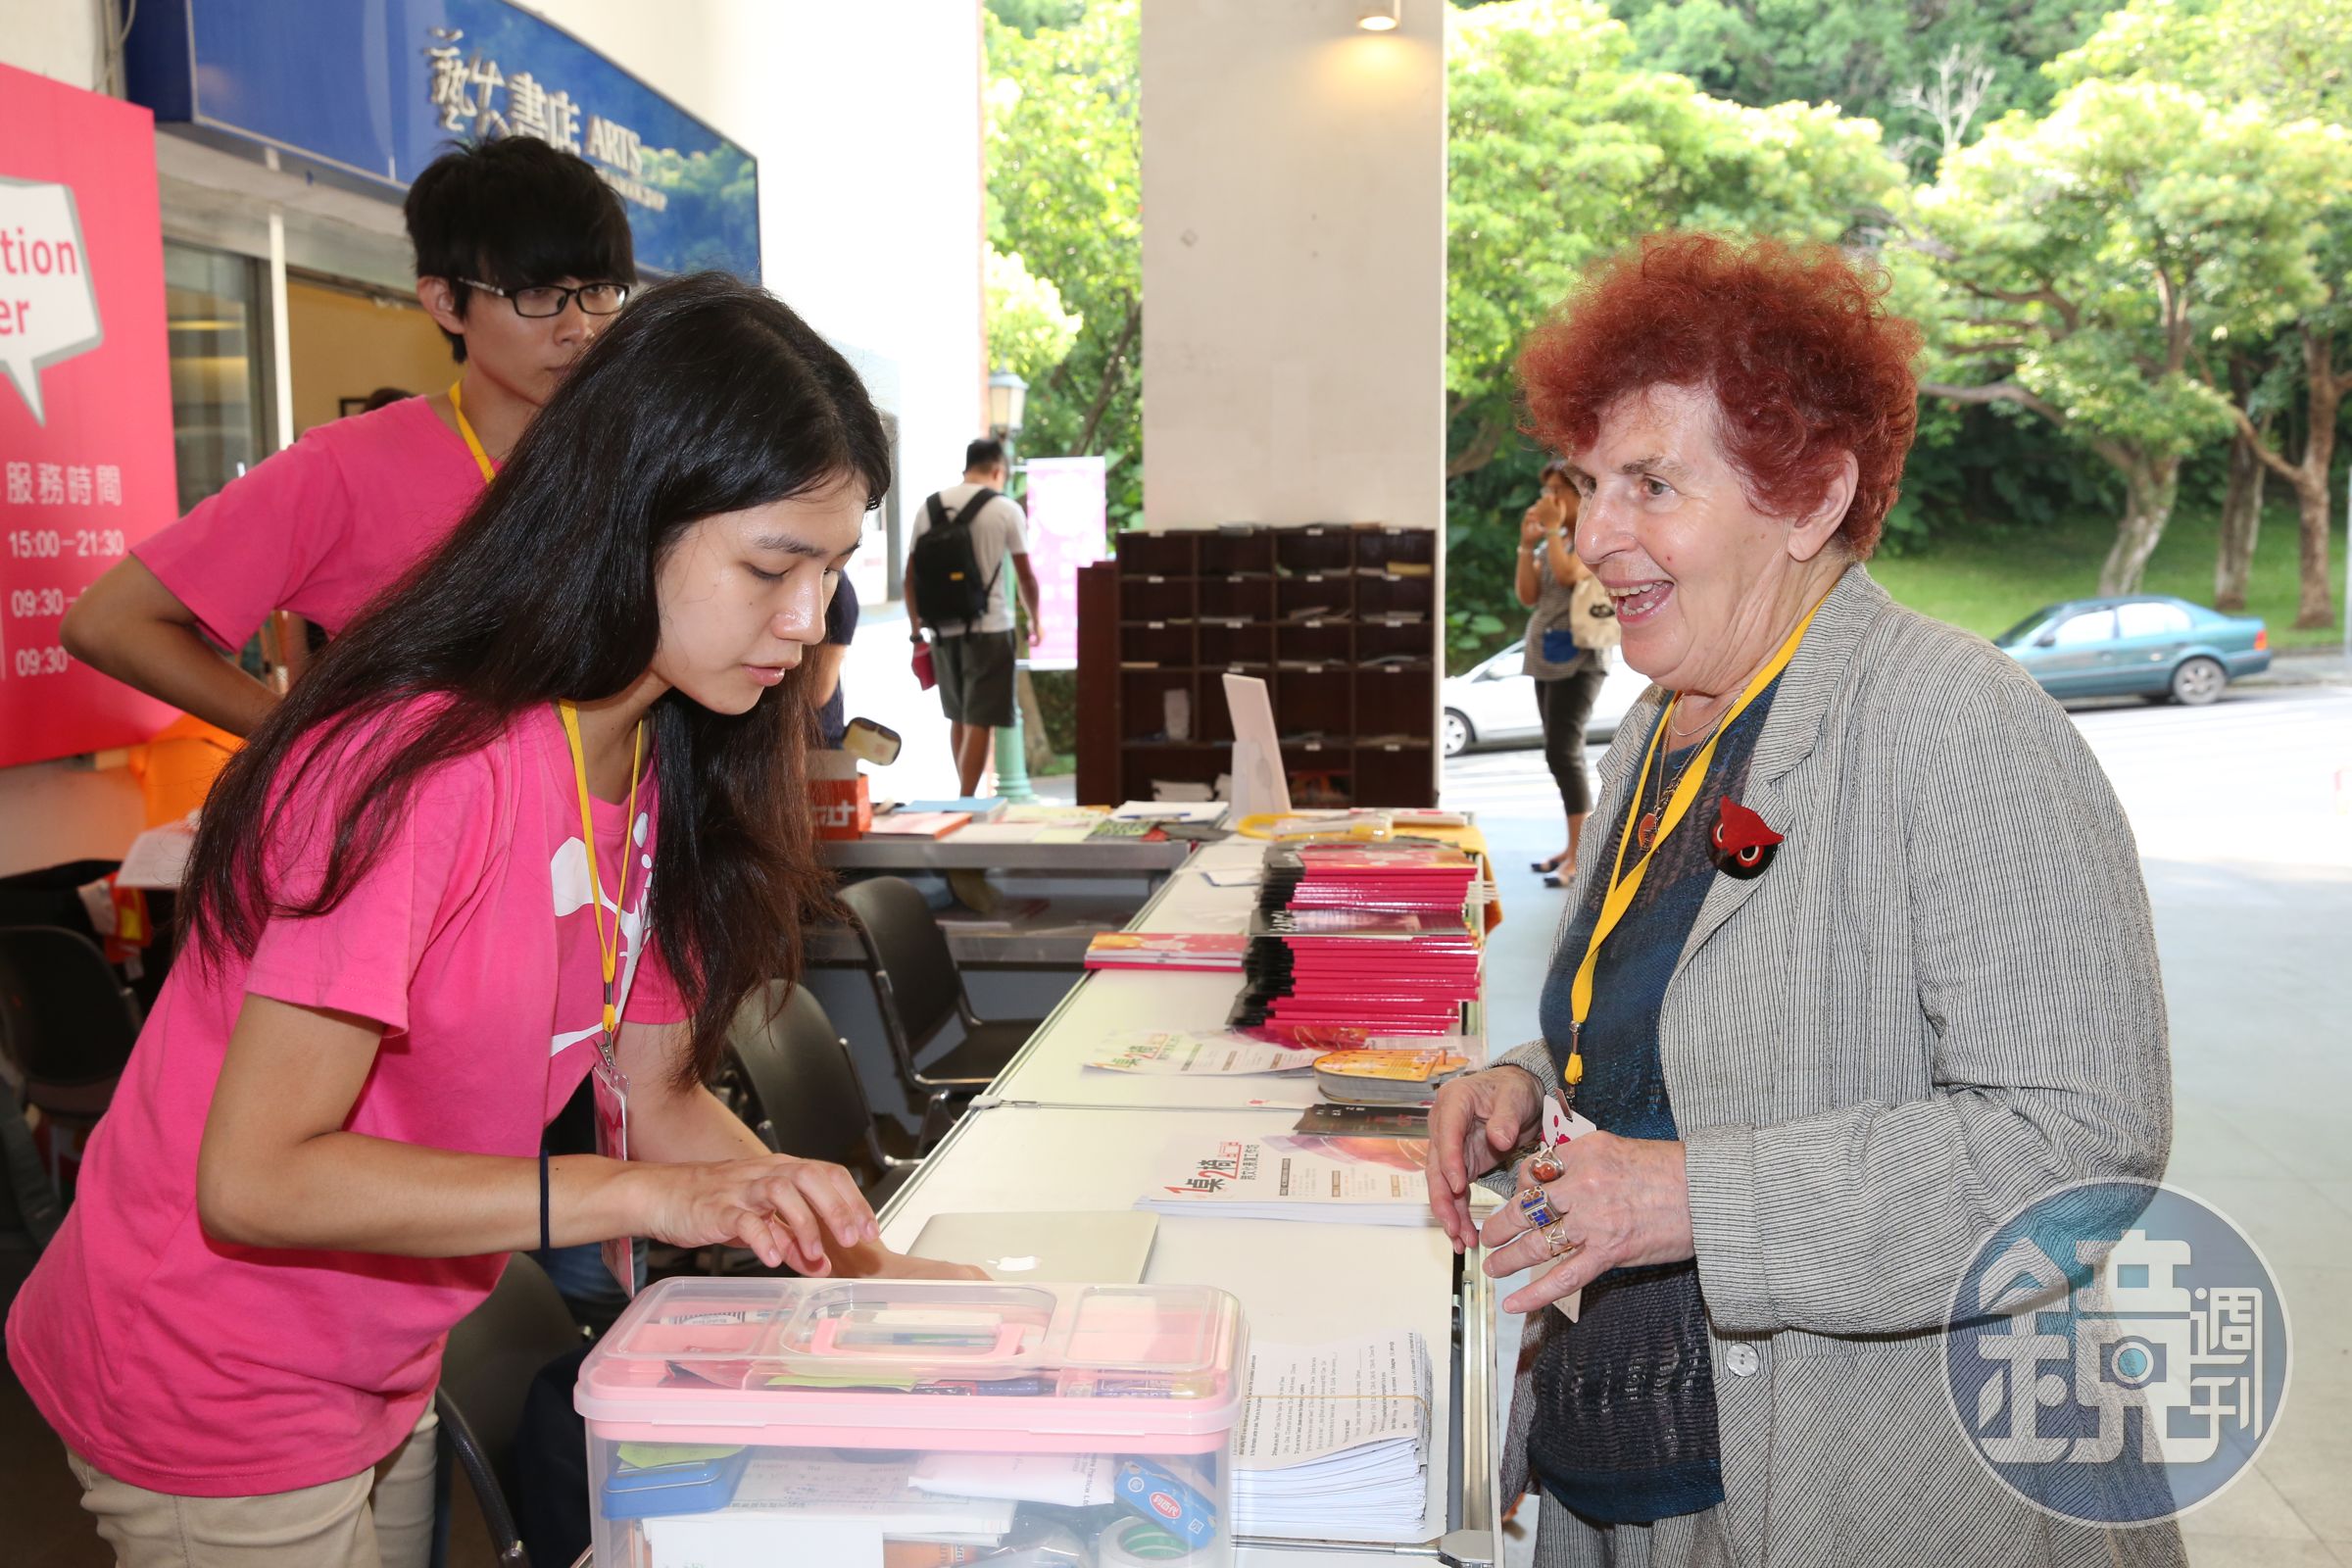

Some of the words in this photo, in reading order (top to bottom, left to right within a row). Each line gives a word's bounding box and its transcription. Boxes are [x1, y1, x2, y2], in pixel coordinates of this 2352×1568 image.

[587, 115, 642, 176] ARTS
[0, 226, 77, 275] tion
[6, 461, 122, 507] 服務時間
